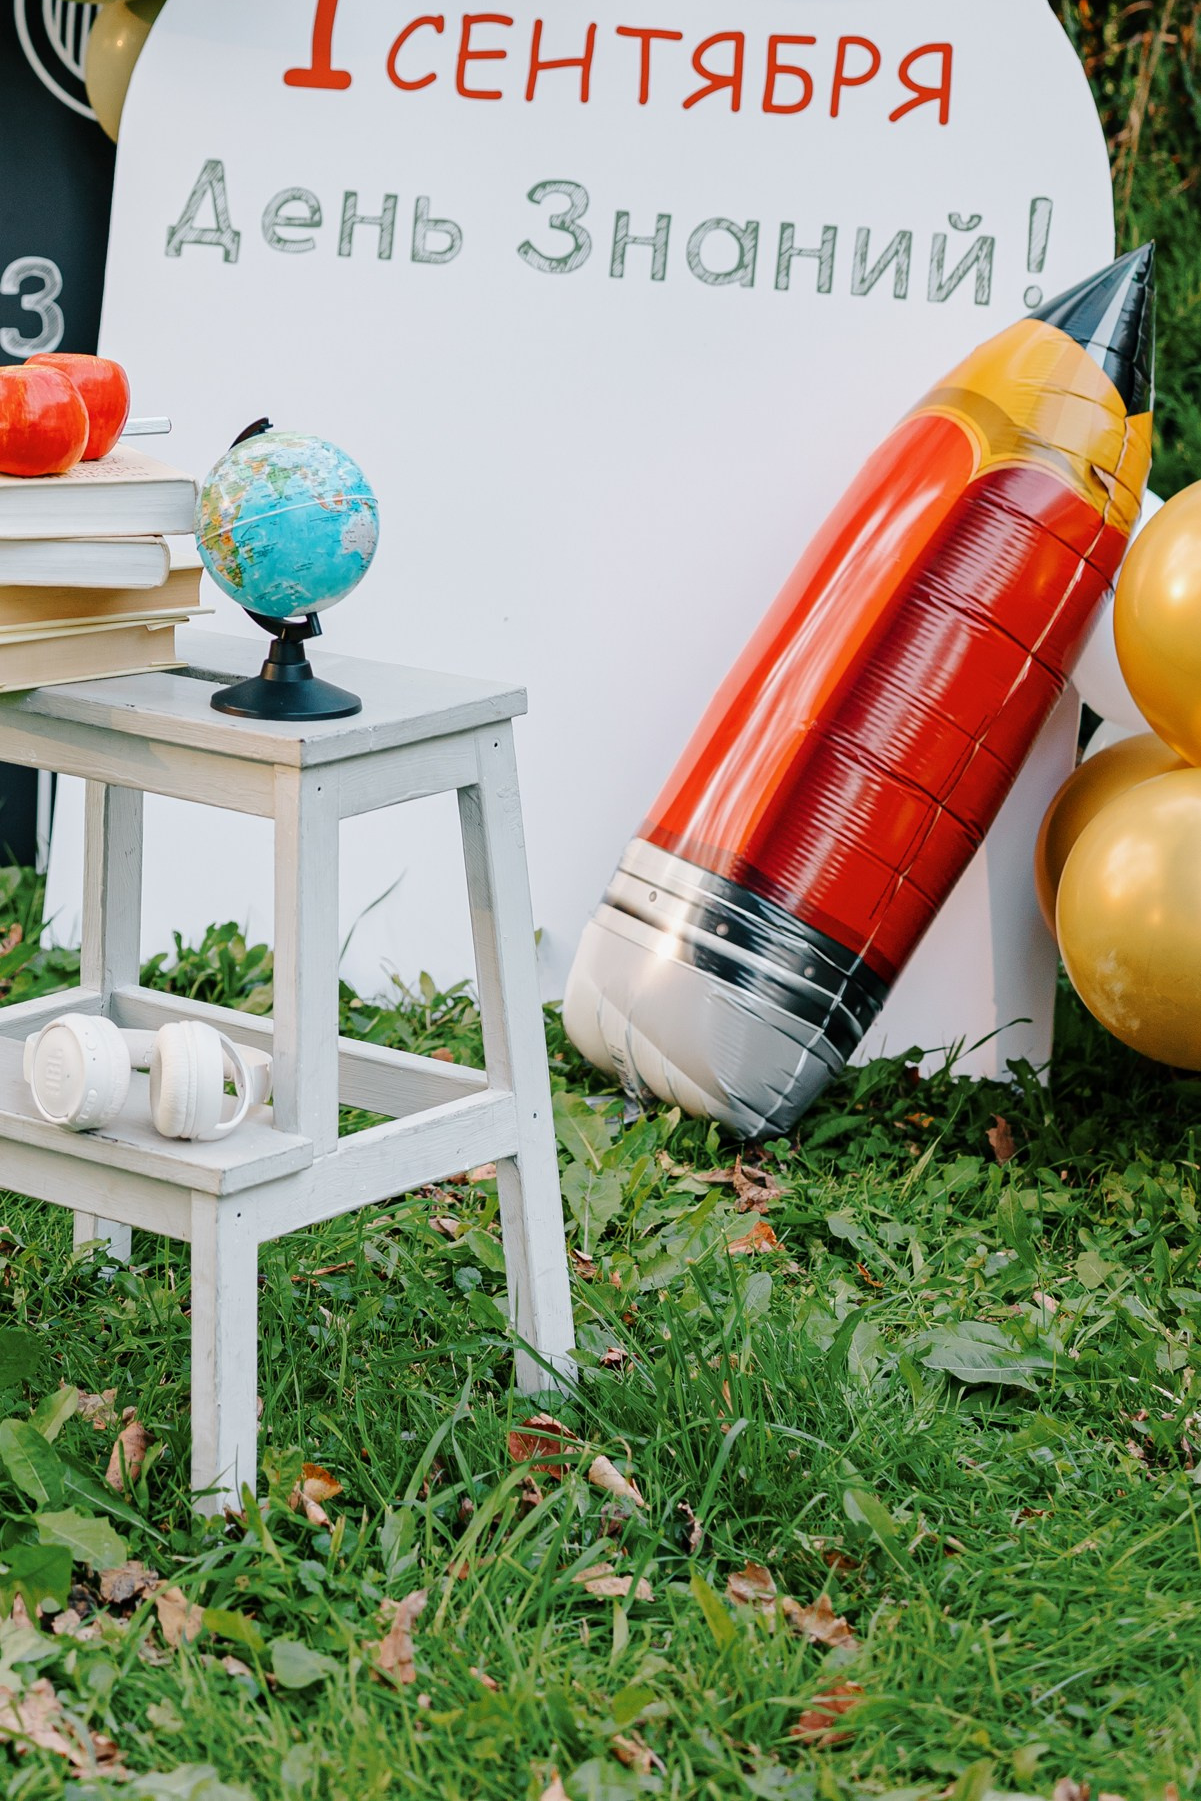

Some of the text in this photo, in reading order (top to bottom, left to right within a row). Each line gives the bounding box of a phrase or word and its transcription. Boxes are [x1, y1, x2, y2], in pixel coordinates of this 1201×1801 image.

[386, 13, 953, 126] СЕНТЯБРЯ
[166, 159, 1053, 308] День Знаний!
[0, 256, 65, 358] 3
